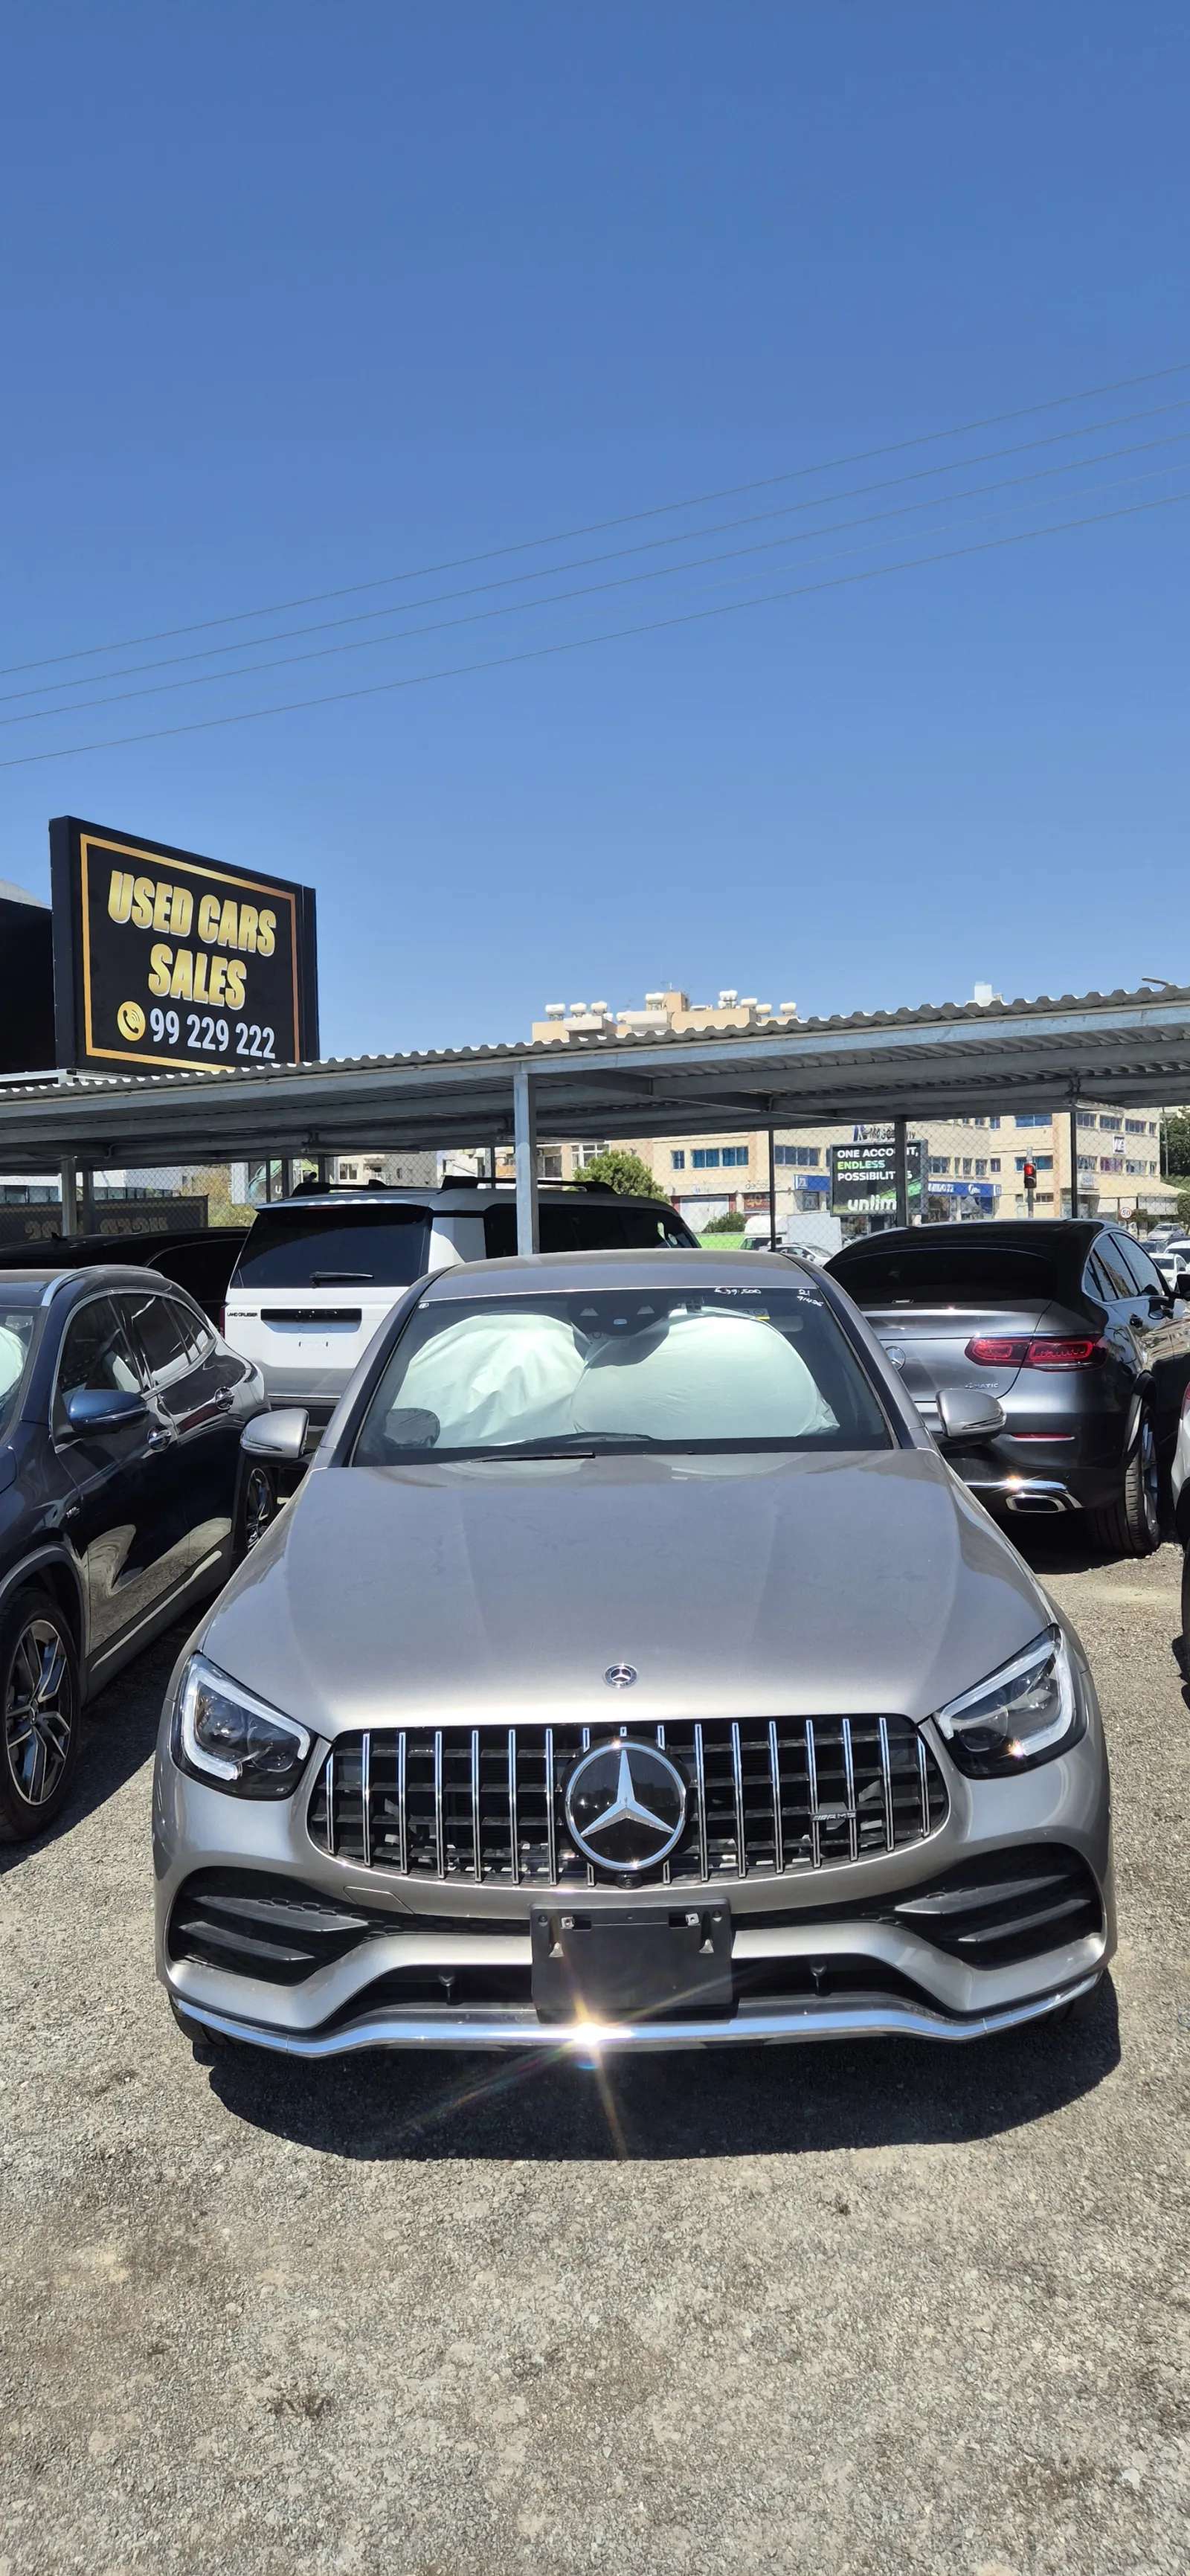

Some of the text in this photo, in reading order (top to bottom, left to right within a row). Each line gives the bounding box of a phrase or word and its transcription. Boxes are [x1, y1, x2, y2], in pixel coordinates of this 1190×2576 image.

[108, 870, 276, 957] USED CARS
[148, 943, 247, 1010] SALES
[150, 1008, 276, 1059] 99 229 222
[837, 1147, 919, 1158] ONE ACCOT,
[837, 1160, 886, 1170] ENDLESS
[837, 1170, 913, 1181] POSSIBILITS
[848, 1195, 898, 1211] unlim
